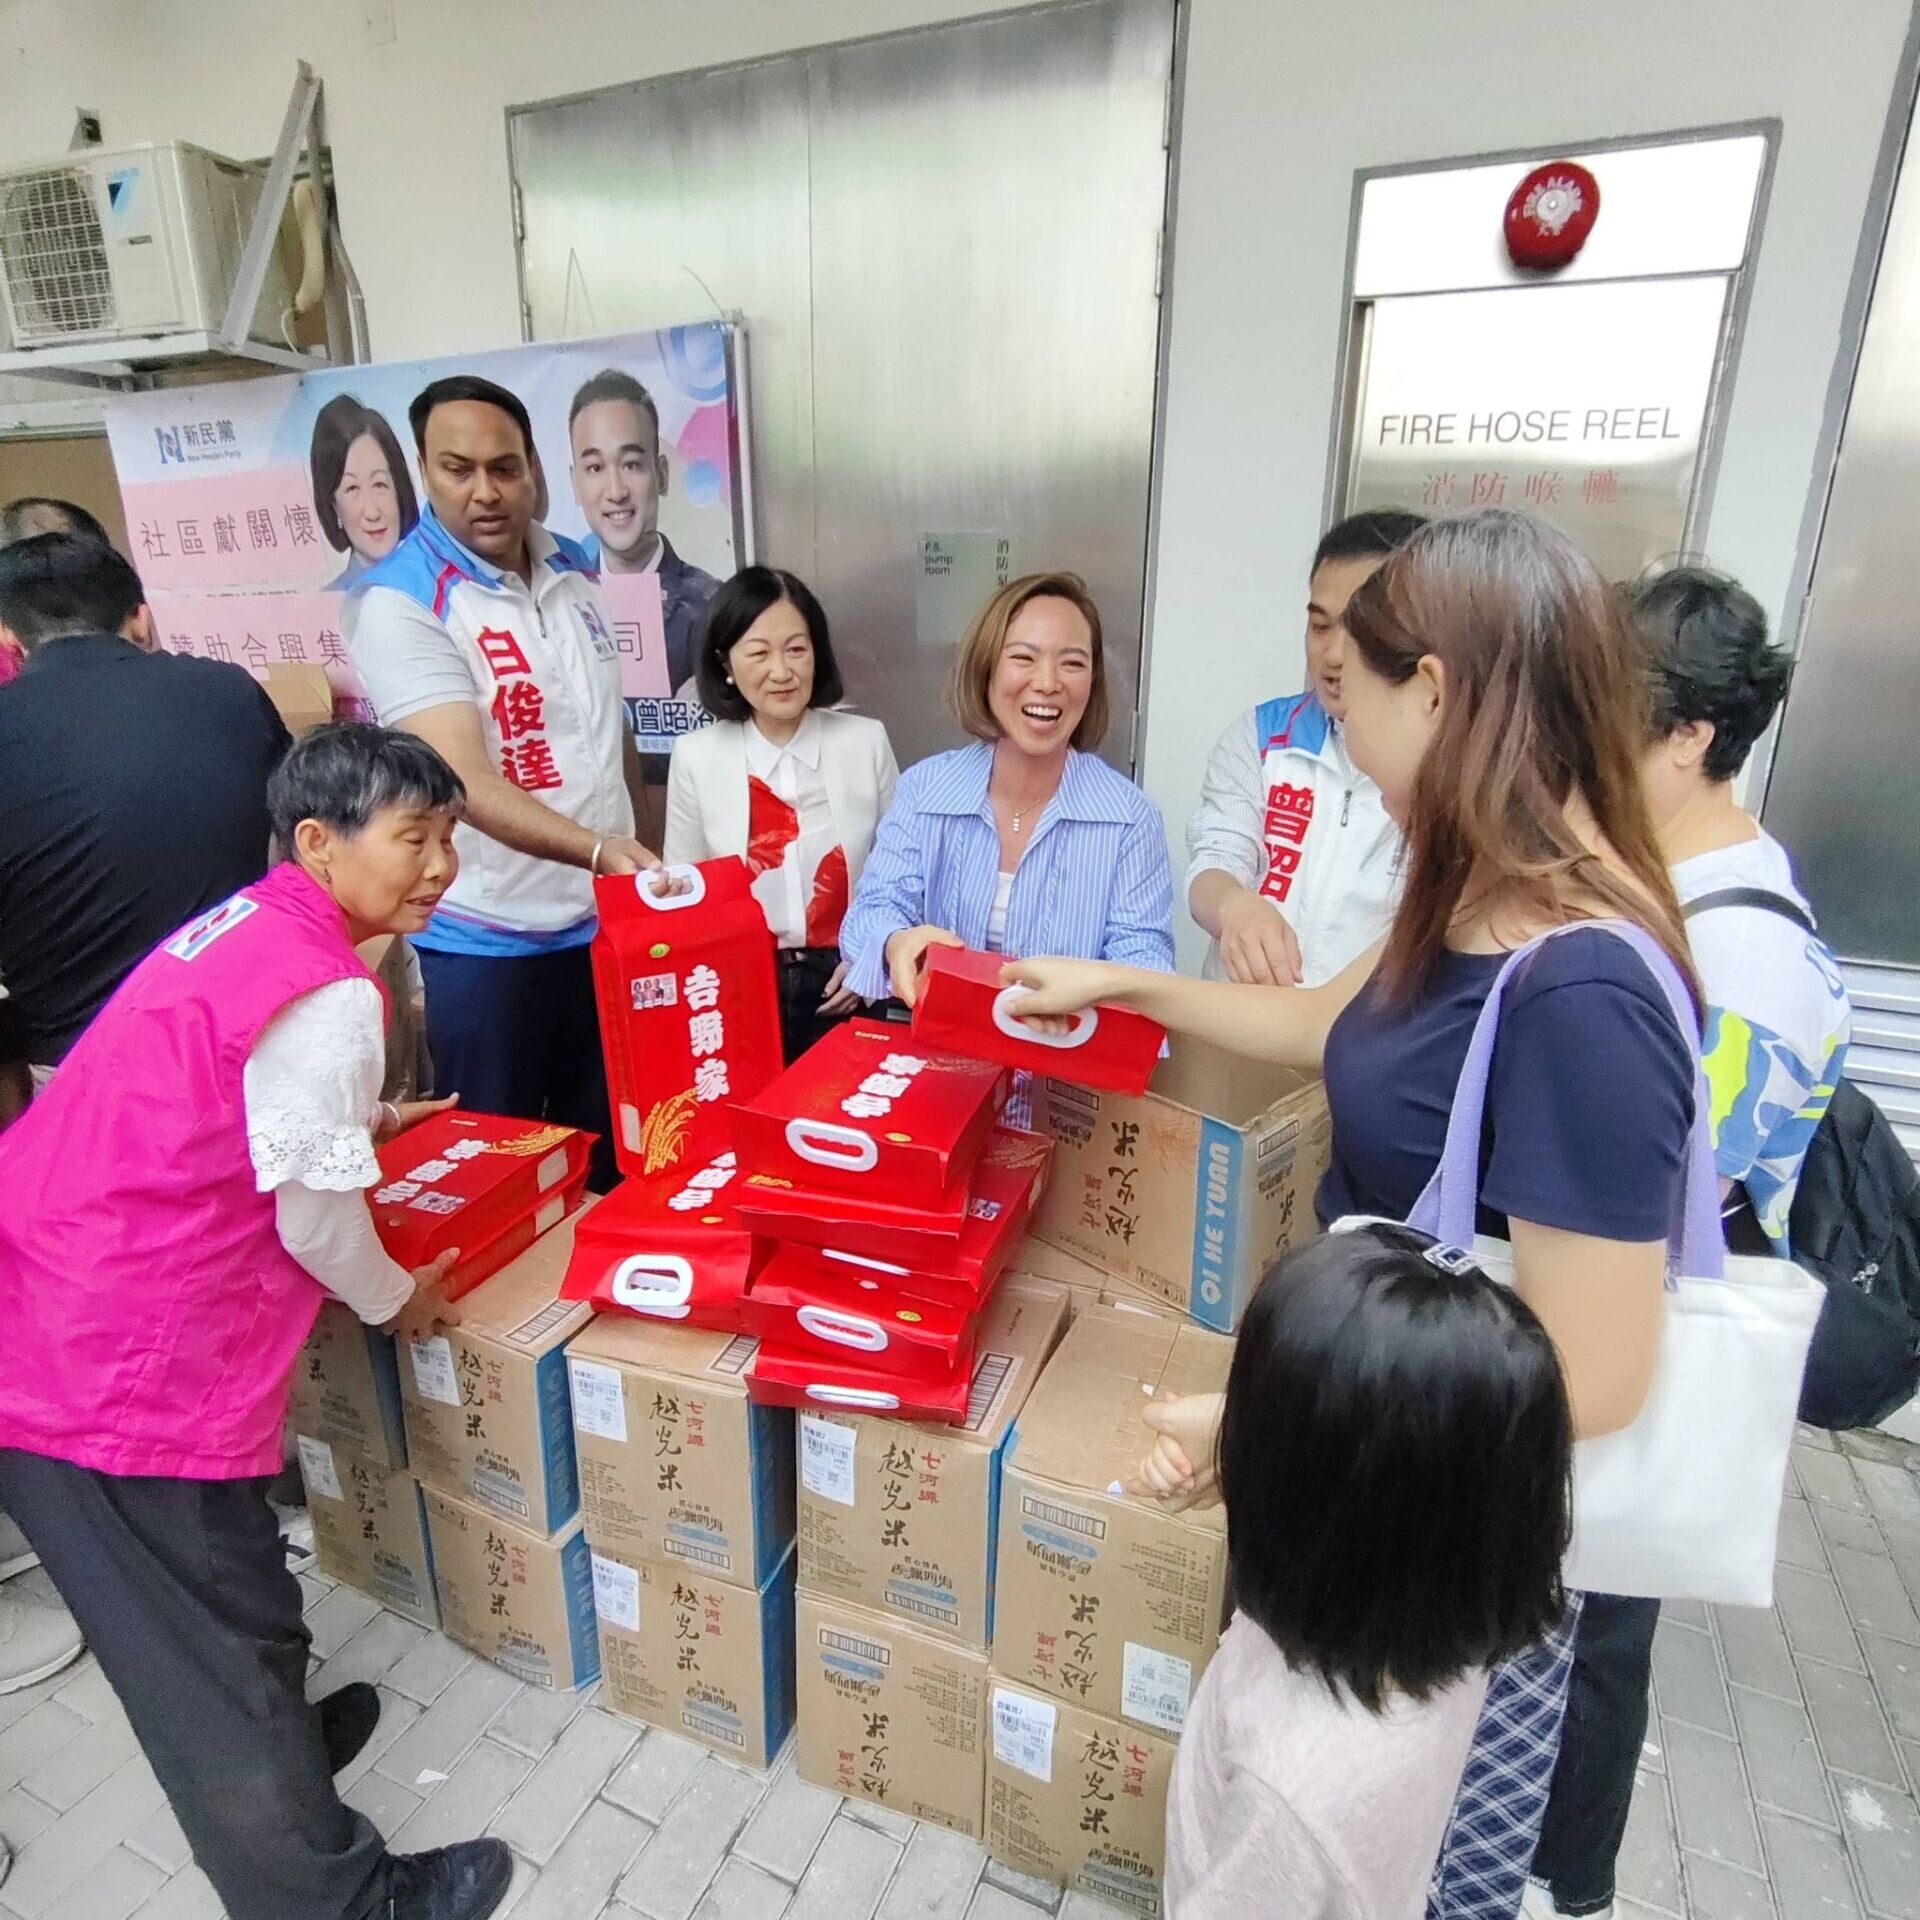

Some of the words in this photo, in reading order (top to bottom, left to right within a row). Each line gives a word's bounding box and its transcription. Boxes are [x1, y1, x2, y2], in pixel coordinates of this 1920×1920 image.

[182, 418, 236, 447] 新民黨
[1378, 413, 1457, 446] FIRE
[1467, 409, 1572, 444] HOSE
[1582, 407, 1681, 441] REEL
[139, 502, 319, 561] 社區獻關懷
[924, 555, 953, 566] pump
[924, 566, 951, 576] room
[475, 625, 563, 792] 白俊達
[1104, 1120, 1141, 1247] 越光米
[456, 1346, 487, 1441] 越光米
[684, 1400, 706, 1448] 七河源
[648, 1390, 683, 1492] 越光米
[918, 1451, 942, 1505] 七河源
[877, 1439, 915, 1548] 越光米
[481, 1530, 511, 1618] 越光米
[670, 1581, 700, 1672] 越光米
[1059, 1593, 1100, 1699] 越光米
[858, 1711, 892, 1799] 越光米
[1078, 1729, 1121, 1835] 越光米
[1121, 1743, 1149, 1798] 七河源
